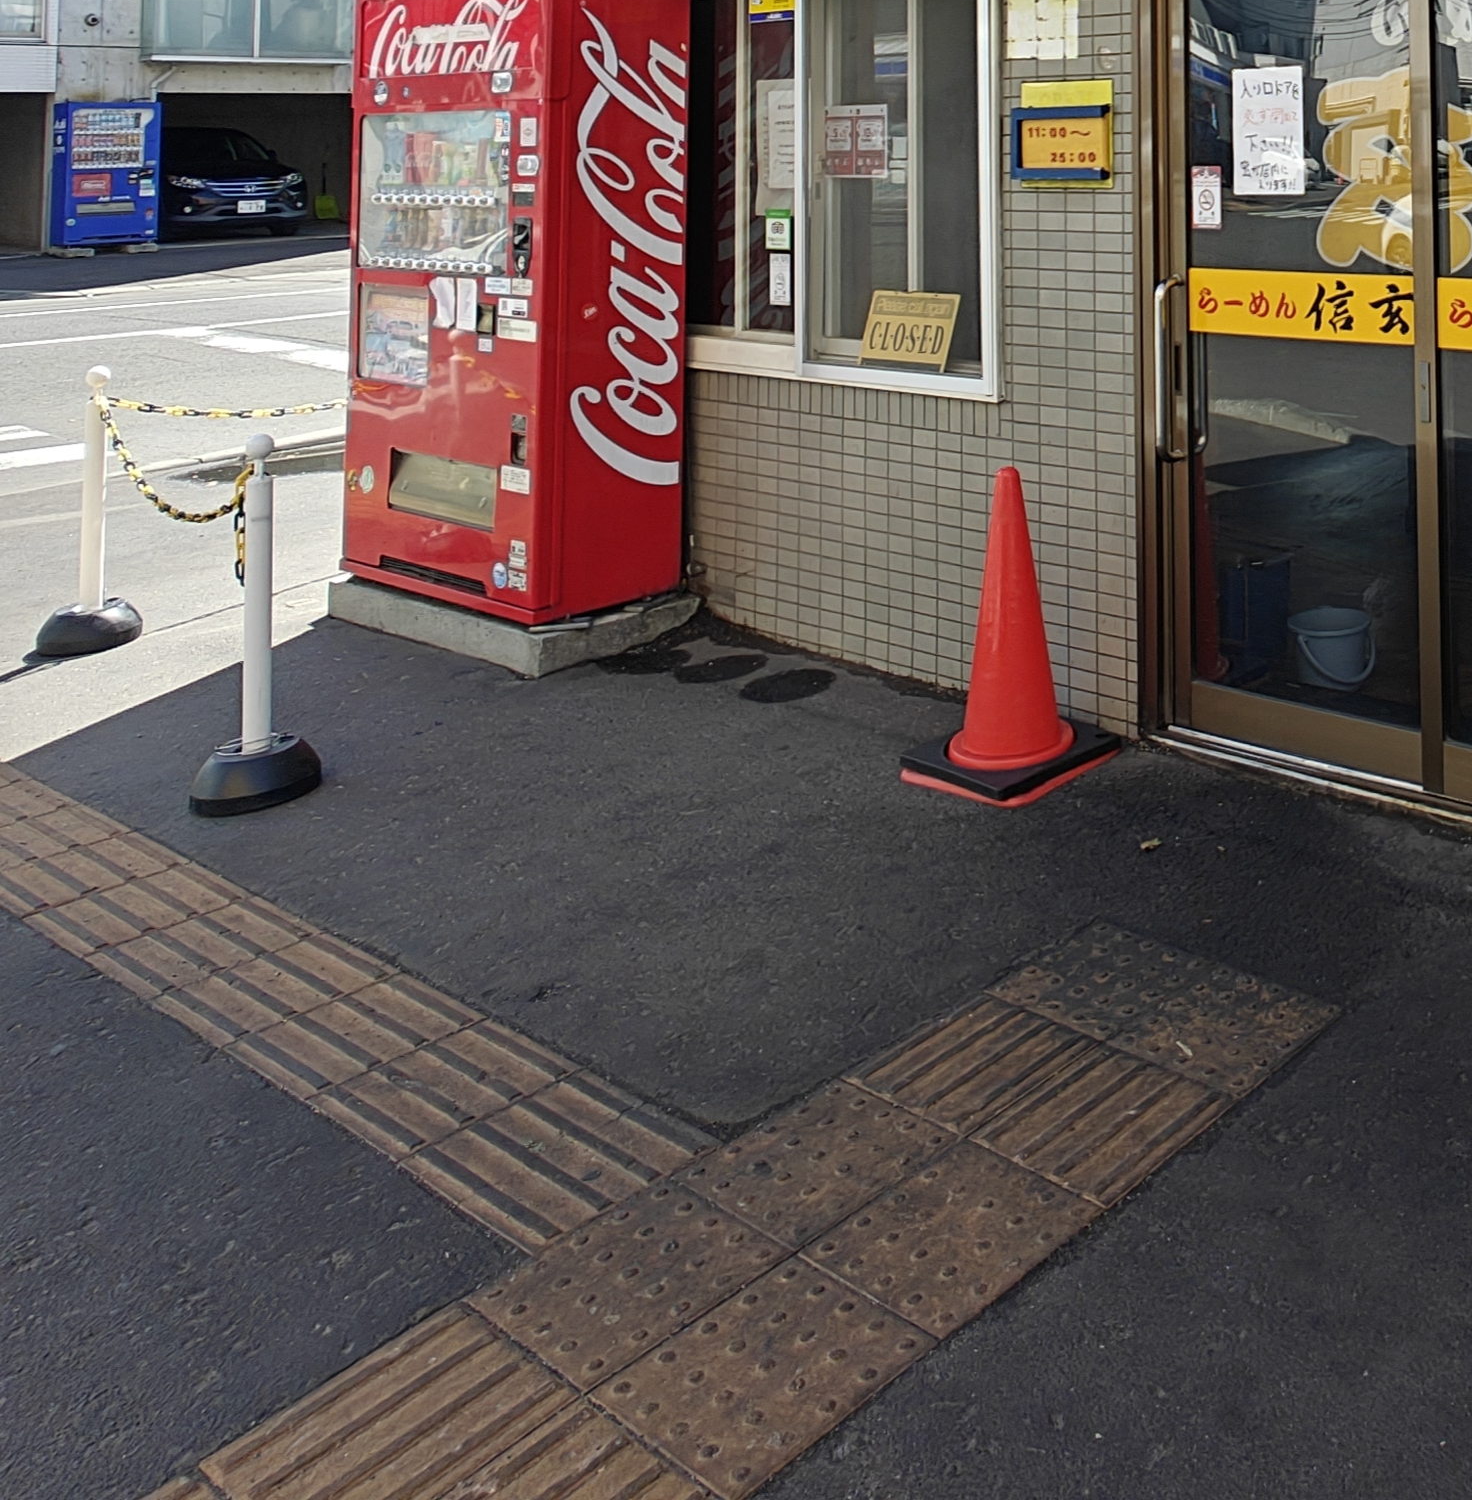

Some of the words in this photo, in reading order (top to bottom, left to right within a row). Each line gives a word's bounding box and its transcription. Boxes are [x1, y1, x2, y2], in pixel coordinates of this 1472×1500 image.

[1050, 152, 1096, 163] 25:00
[569, 5, 687, 486] Coca-Cola
[1197, 287, 1297, 320] らーめん
